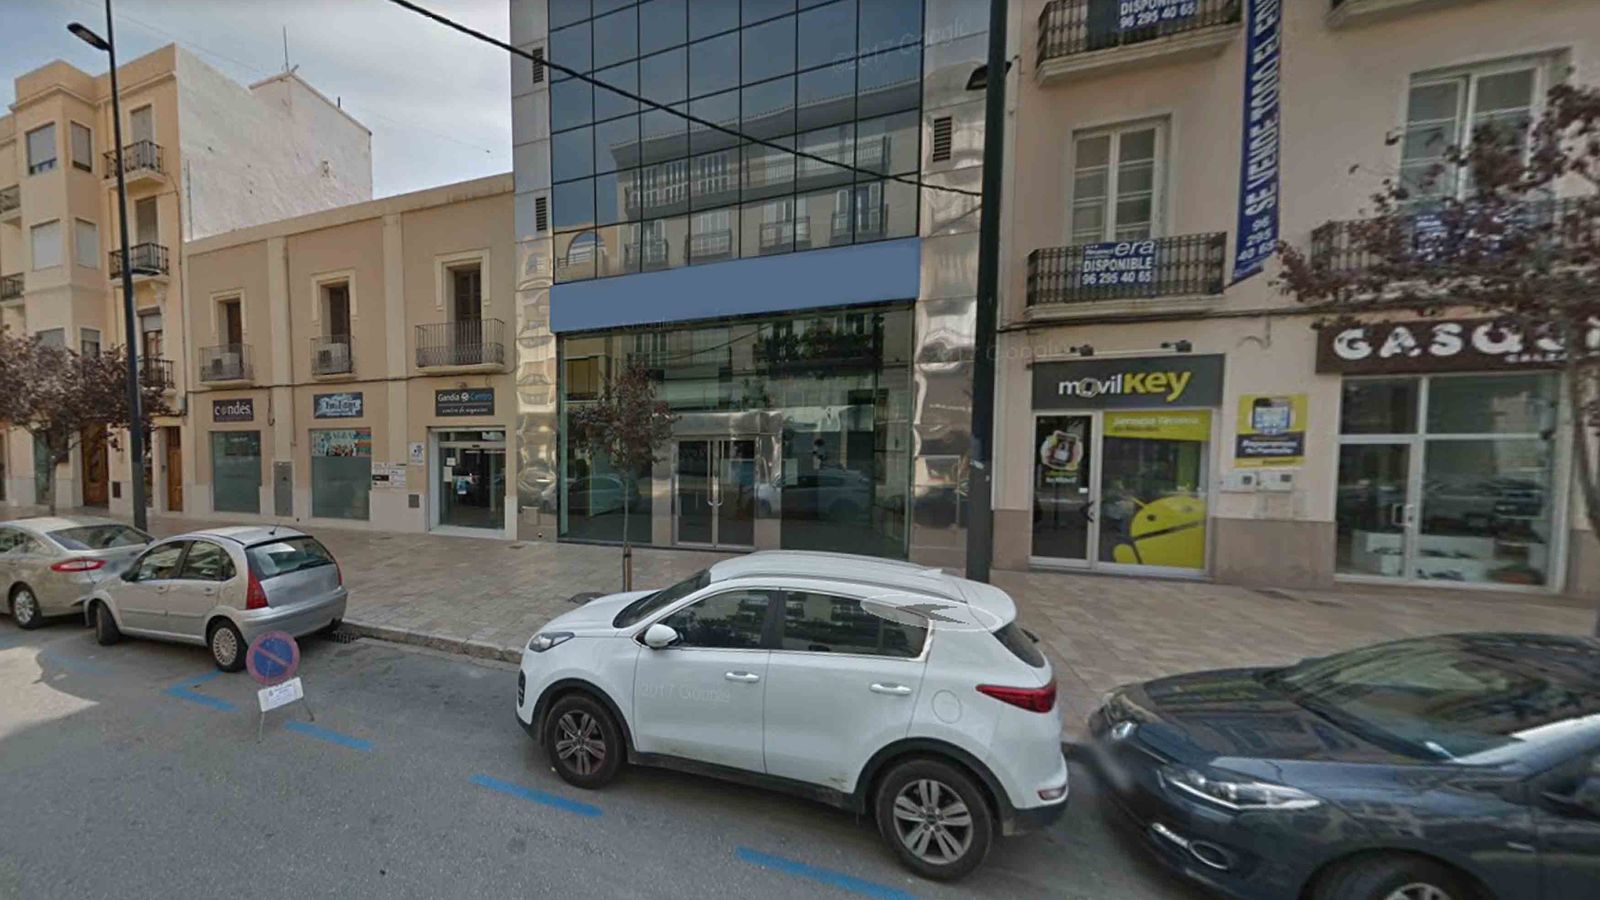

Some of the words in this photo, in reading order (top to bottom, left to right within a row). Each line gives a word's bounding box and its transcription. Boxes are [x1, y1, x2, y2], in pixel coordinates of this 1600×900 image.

[1120, 14, 1135, 28] 96
[1137, 10, 1159, 25] 295
[1162, 6, 1177, 19] 40
[1181, 2, 1195, 16] 65
[1121, 0, 1195, 16] DISPON
[1253, 22, 1281, 65] EL
[1251, 54, 1280, 123] TODO
[1247, 112, 1280, 190] VENDE
[1244, 182, 1277, 216] SE
[1114, 240, 1154, 256] era
[1082, 272, 1097, 285] 96
[1099, 271, 1119, 285] 295
[1120, 271, 1136, 283] 40
[1138, 270, 1152, 282] 65
[1083, 257, 1153, 273] DISPONIBLE
